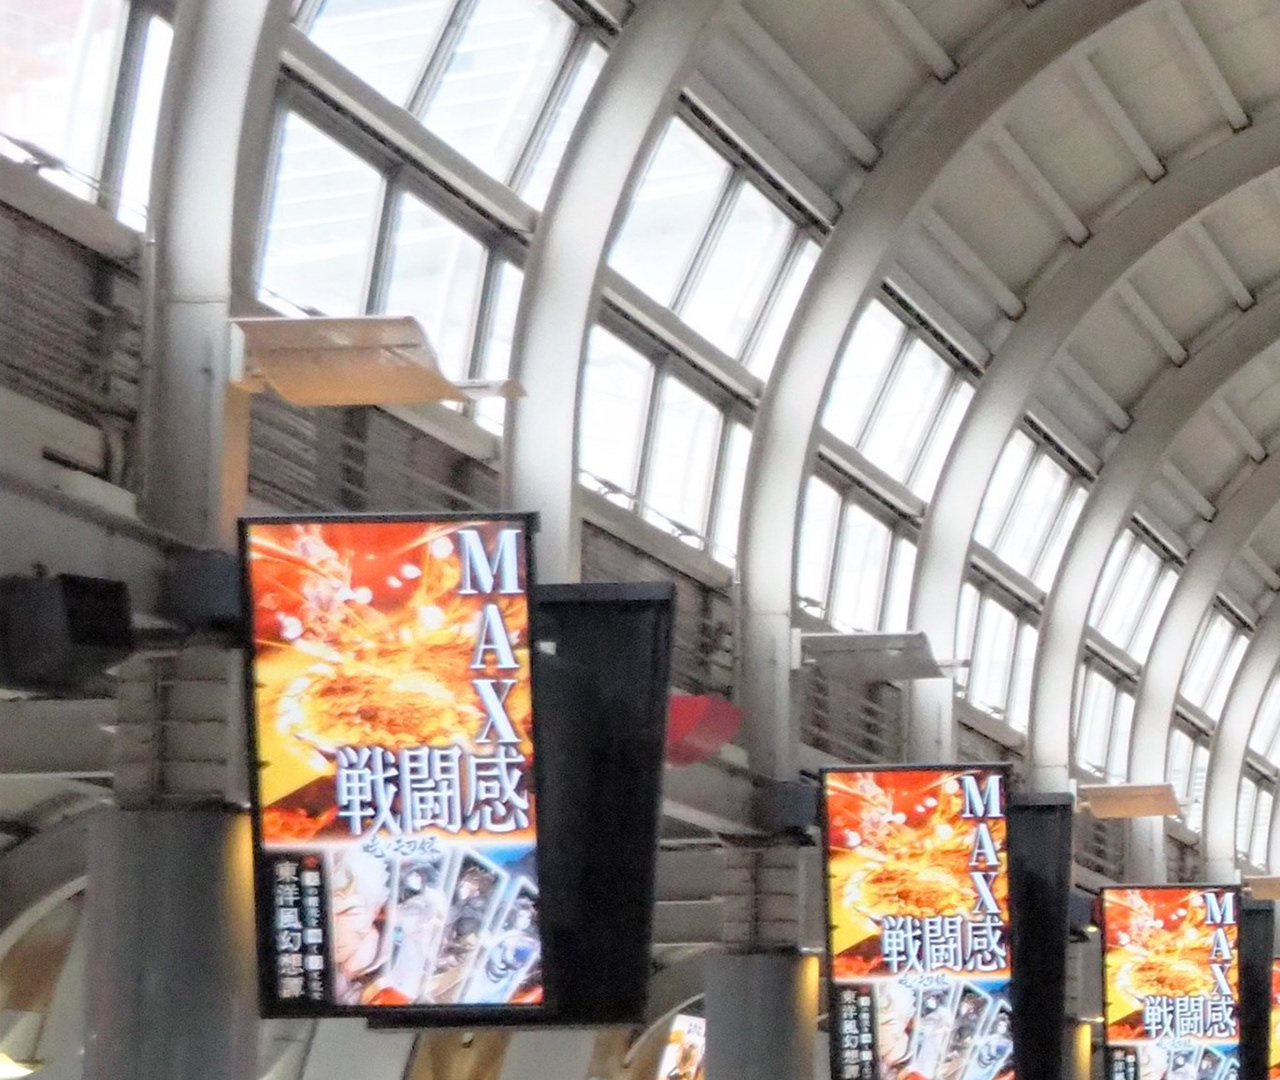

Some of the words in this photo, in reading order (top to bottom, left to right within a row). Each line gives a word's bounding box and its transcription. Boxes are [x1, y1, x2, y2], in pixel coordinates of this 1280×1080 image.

[458, 529, 524, 743] MAX
[336, 745, 529, 835] 戦闘感
[961, 775, 1005, 915] MAX
[881, 915, 1007, 973] 戦闘感
[1205, 892, 1236, 996] MAX
[1144, 995, 1236, 1039] 戦闘感
